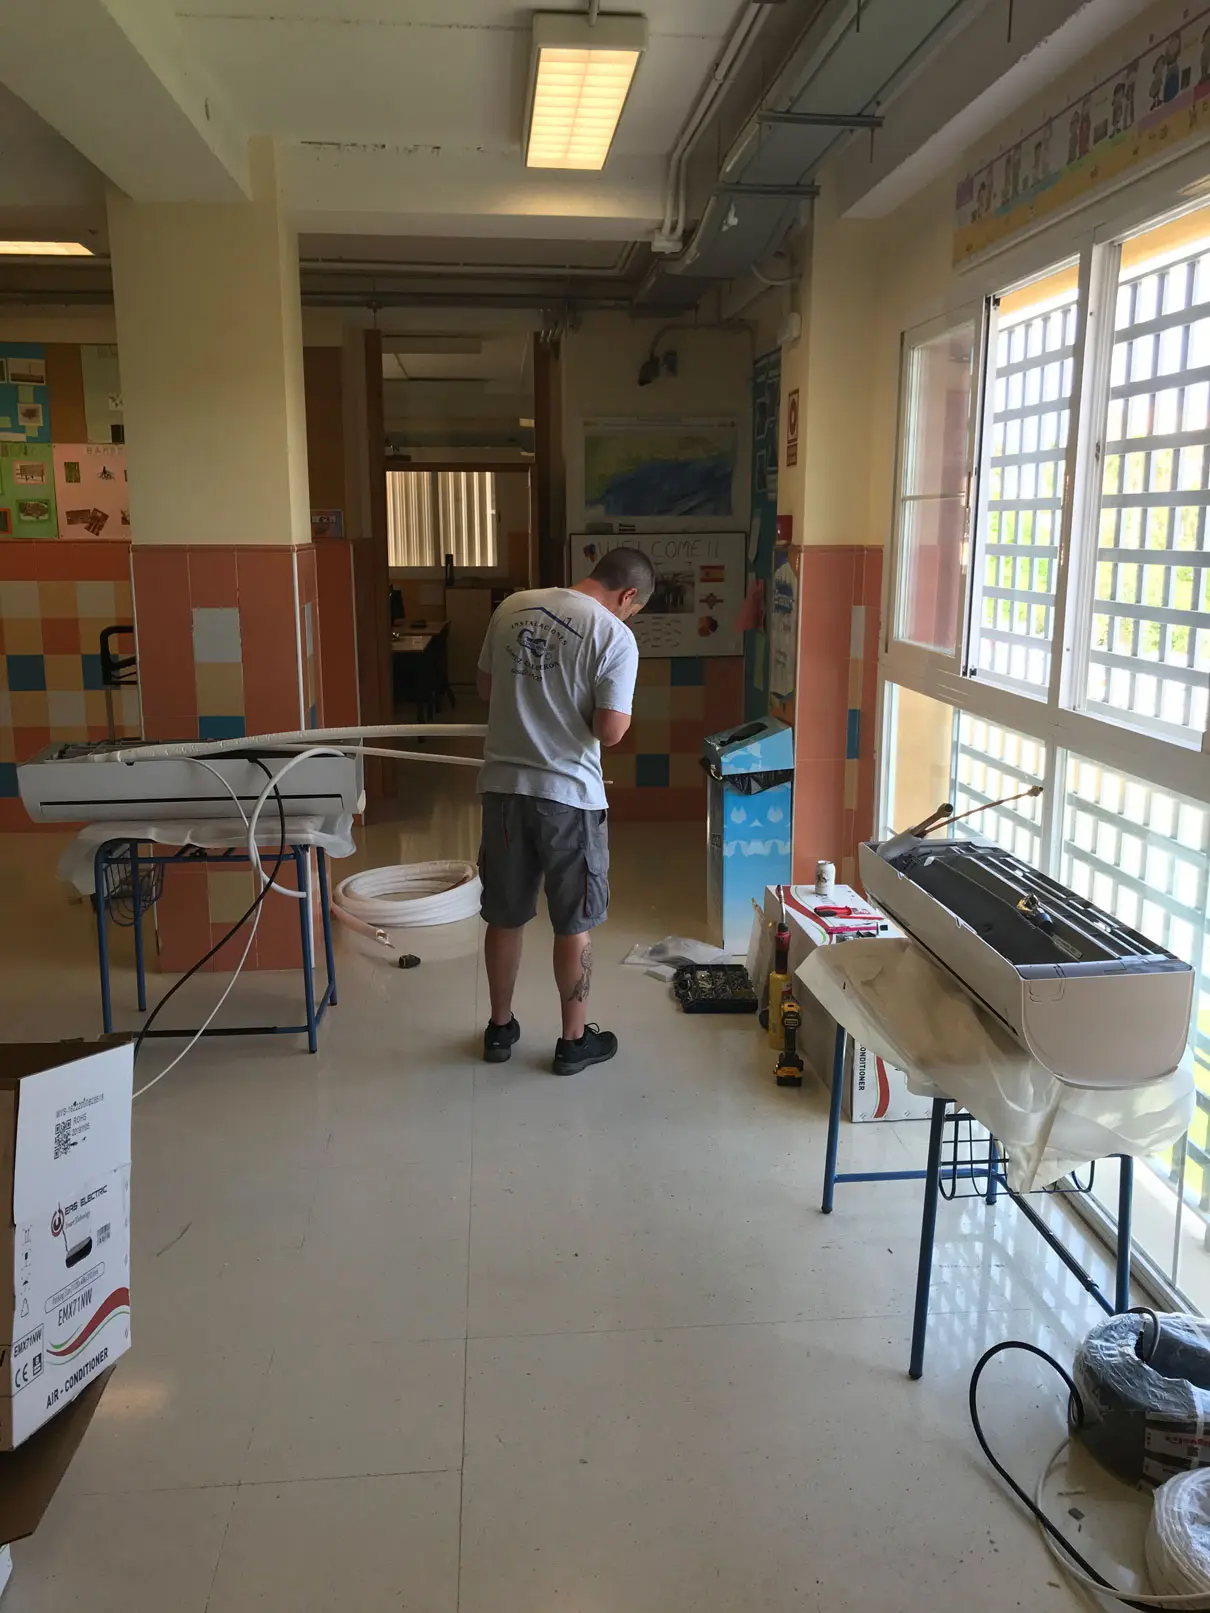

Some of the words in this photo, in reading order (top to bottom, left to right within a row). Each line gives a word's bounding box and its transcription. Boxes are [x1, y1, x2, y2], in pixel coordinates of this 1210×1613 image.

[858, 1045, 867, 1091] ONDITIONER
[80, 1184, 108, 1207] ELECTRIC
[58, 1286, 93, 1327] EMX71NW
[13, 1328, 43, 1359] EMX71NW
[46, 1388, 60, 1410] AIR
[64, 1346, 109, 1393] CONDITIONER
